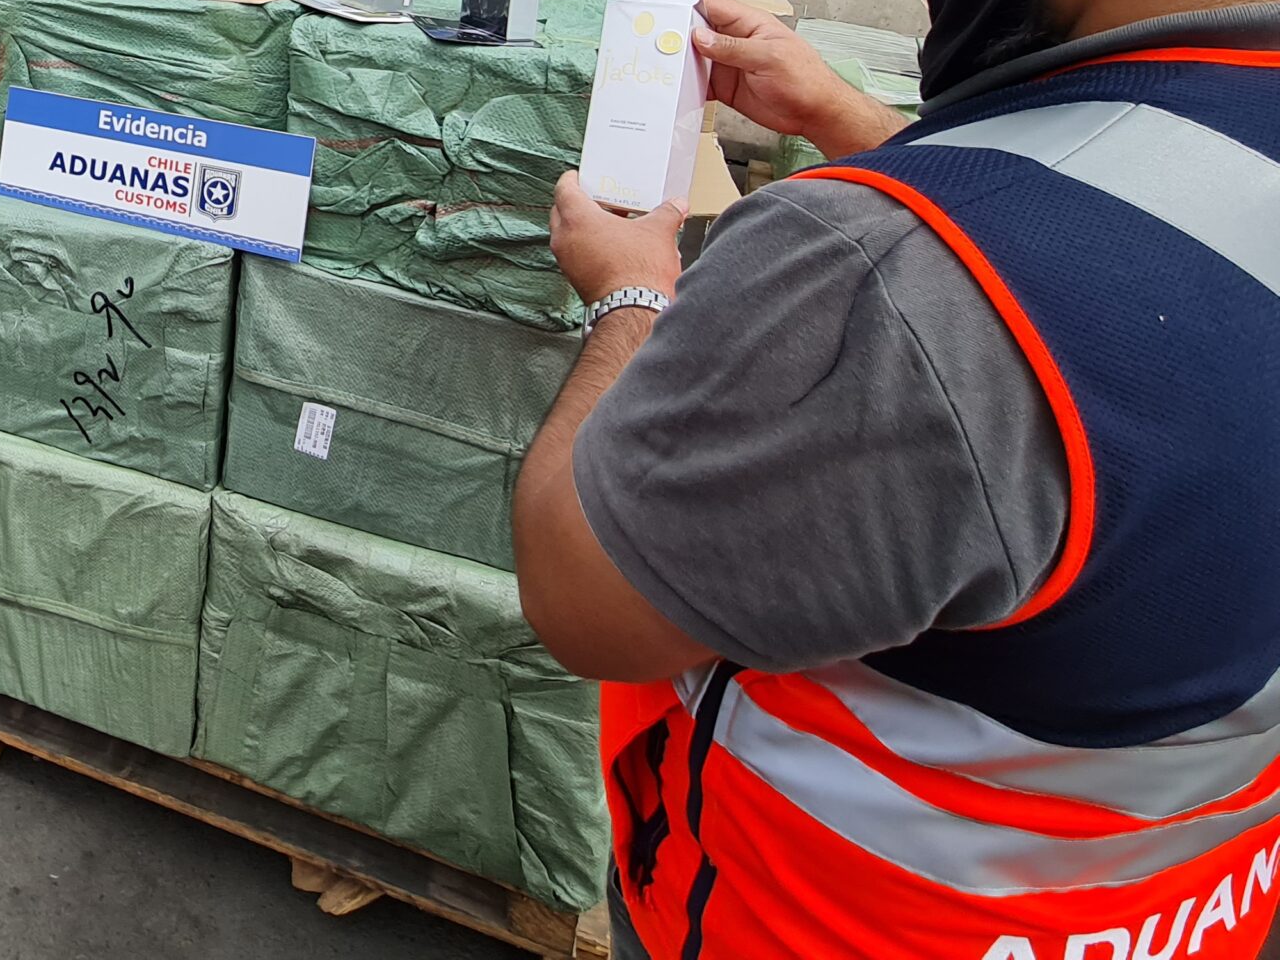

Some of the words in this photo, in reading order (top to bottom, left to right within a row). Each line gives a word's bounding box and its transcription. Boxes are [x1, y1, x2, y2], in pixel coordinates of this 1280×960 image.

[98, 109, 208, 148] Evidencia
[48, 151, 191, 198] ADUANAS
[147, 155, 193, 174] CHILE
[114, 189, 188, 215] CUSTOMS
[980, 834, 1280, 960] UAN
